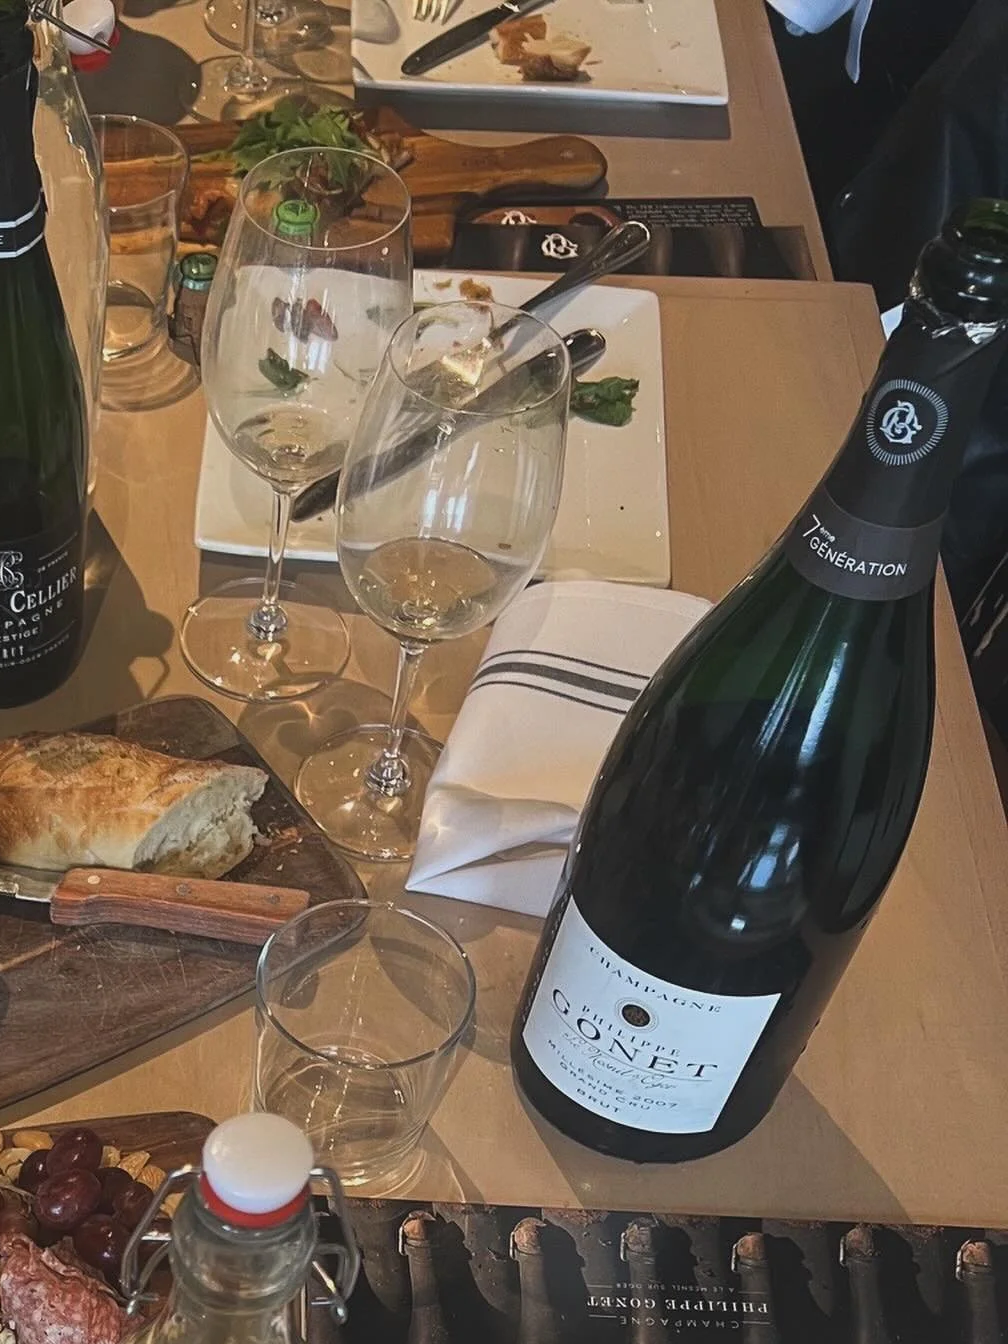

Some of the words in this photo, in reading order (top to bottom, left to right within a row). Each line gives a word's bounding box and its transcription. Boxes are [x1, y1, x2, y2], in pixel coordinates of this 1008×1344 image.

[809, 535, 908, 577] GÉNÉRATION
[10, 565, 77, 613] CELLIER
[588, 945, 722, 1013] CHAMPAGNE
[552, 988, 718, 1079] GONET
[582, 1004, 682, 1058] PHILIPPE
[587, 1295, 657, 1310] GONET
[619, 1315, 740, 1329] CHAMPAGNE
[665, 1298, 768, 1314] PHILIPPE
